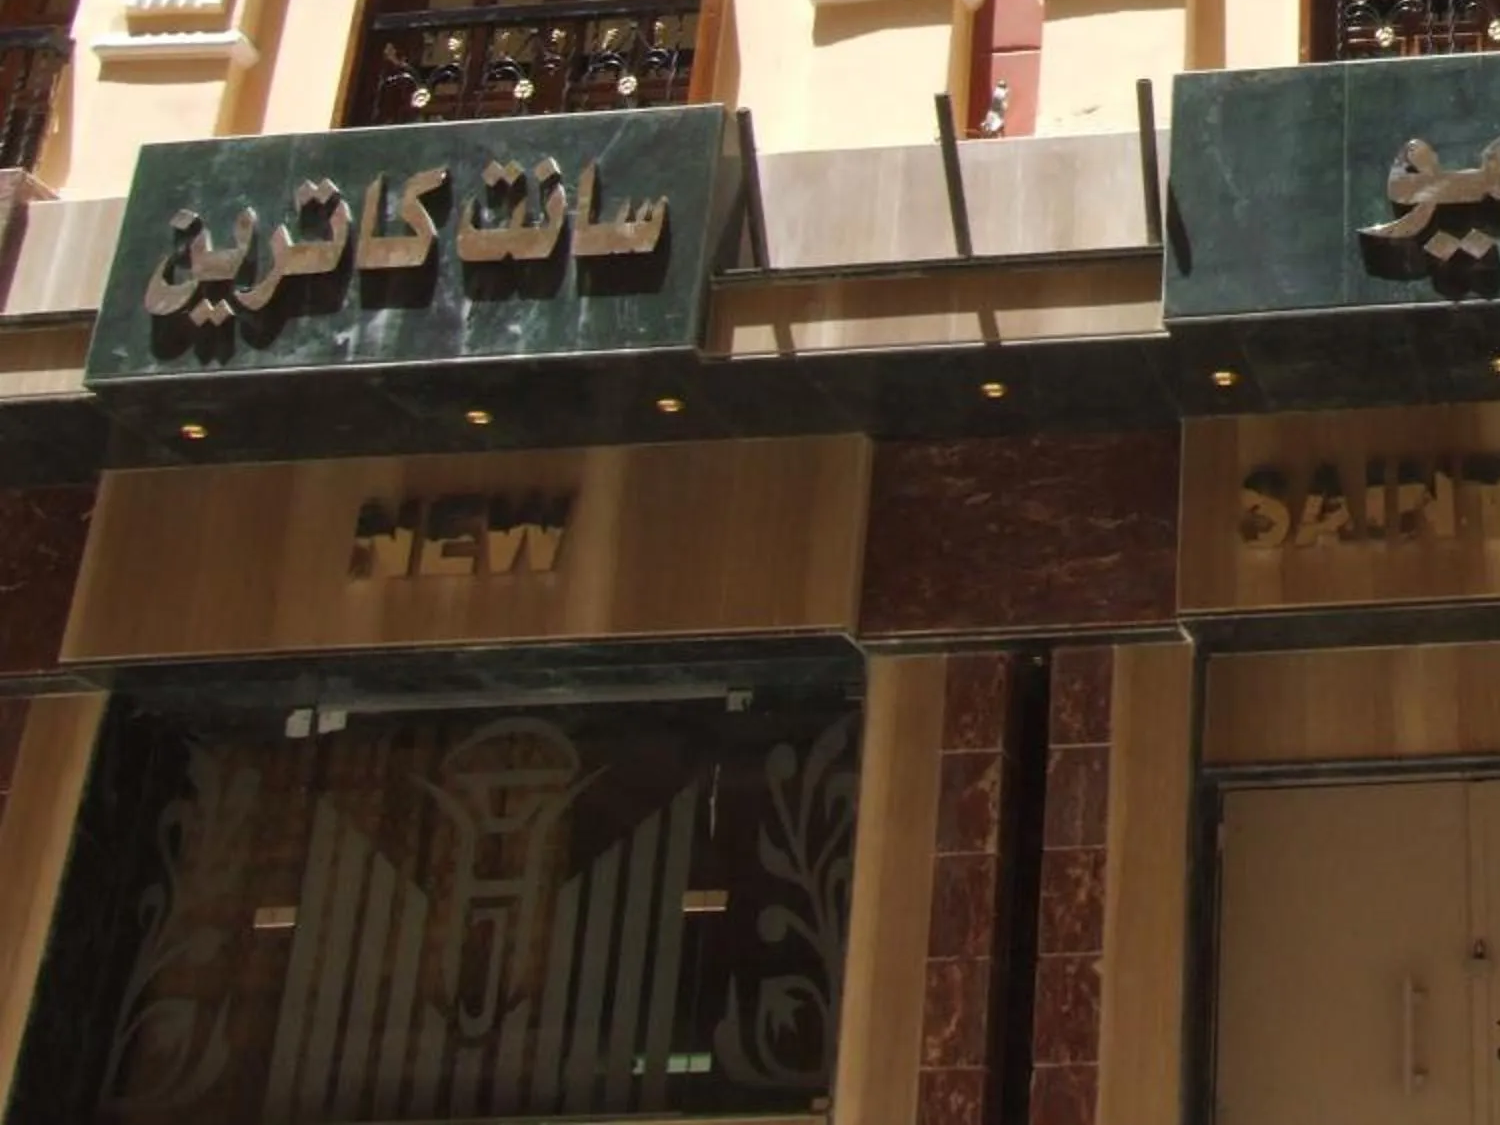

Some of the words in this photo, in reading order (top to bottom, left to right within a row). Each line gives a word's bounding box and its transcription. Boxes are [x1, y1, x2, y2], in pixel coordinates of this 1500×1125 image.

[144, 165, 450, 327] كاترين
[456, 155, 669, 263] سانت
[350, 493, 575, 579] NEW
